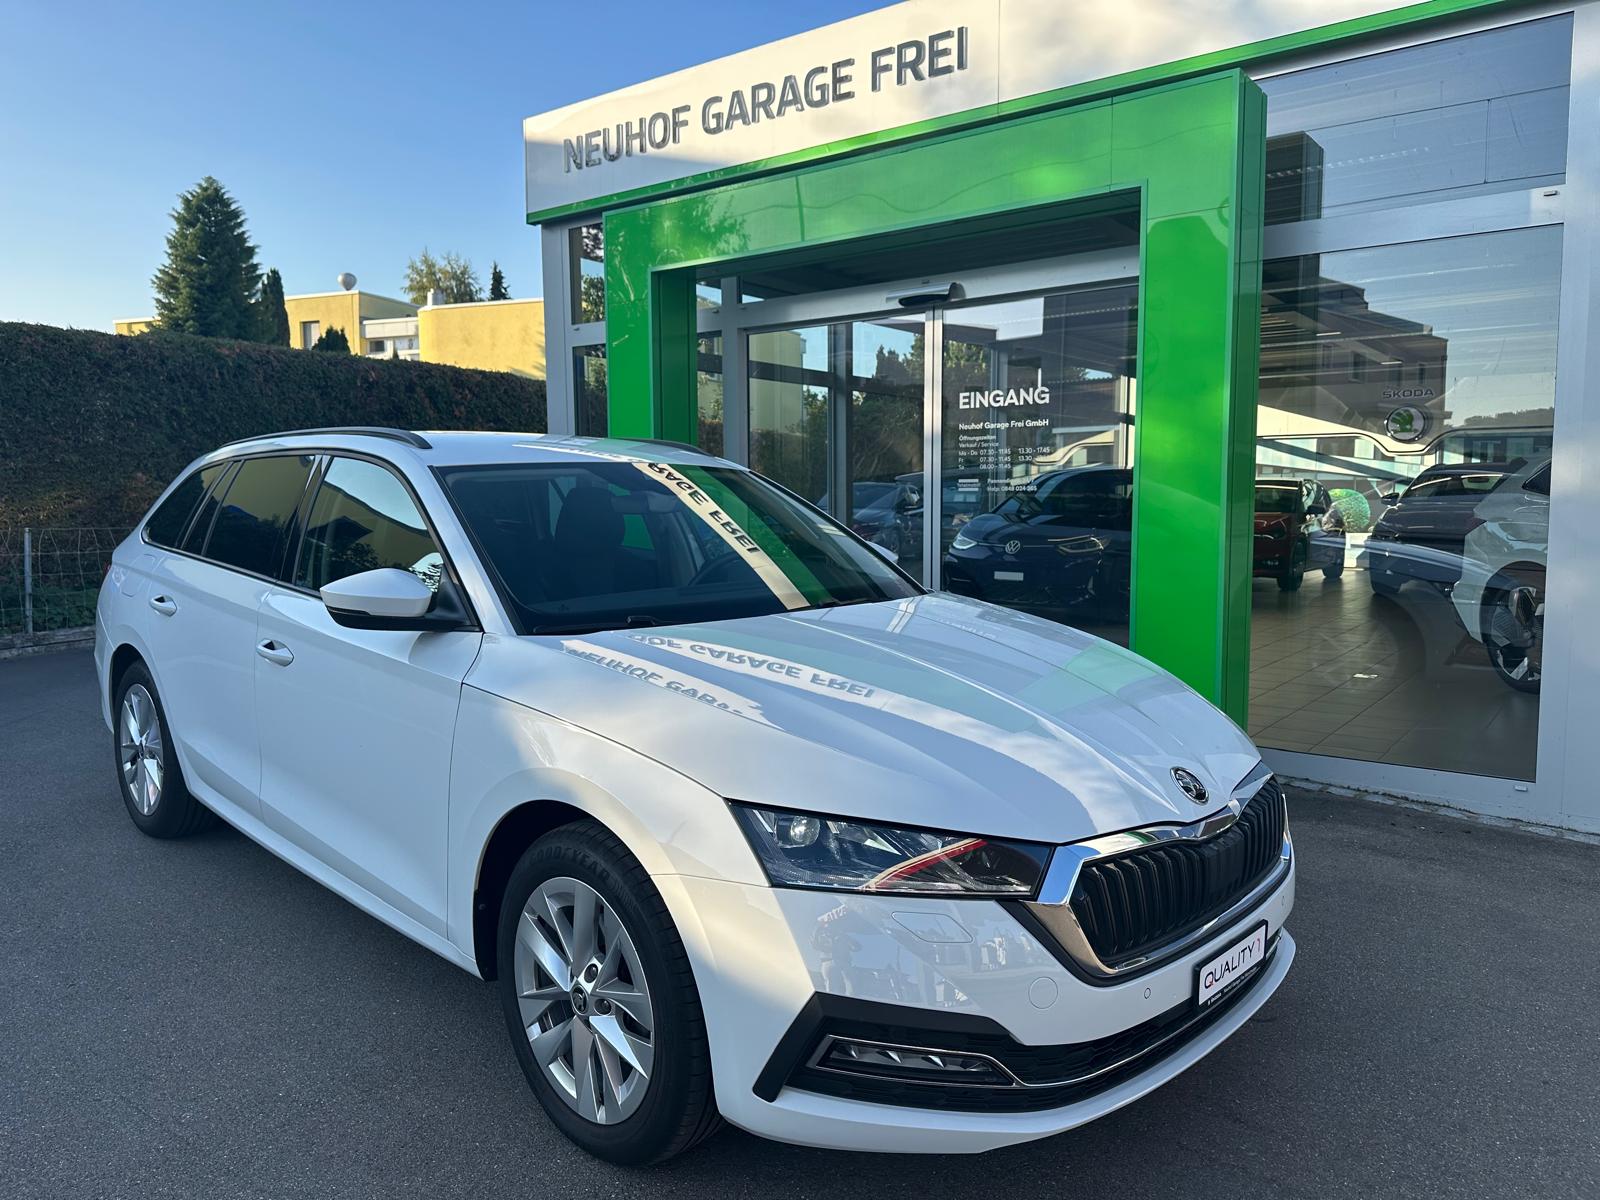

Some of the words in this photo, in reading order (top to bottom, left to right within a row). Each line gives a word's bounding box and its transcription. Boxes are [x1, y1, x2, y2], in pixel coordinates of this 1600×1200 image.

[563, 104, 691, 173] NEUHOF
[701, 57, 856, 136] GARAGE
[870, 26, 969, 93] FREI
[959, 386, 1050, 409] EINGANG
[984, 421, 1009, 429] Garage
[1010, 420, 1025, 428] Frei
[1025, 419, 1049, 427] GmbH
[1204, 941, 1255, 989] QUALITY
[1256, 938, 1261, 952] 1
